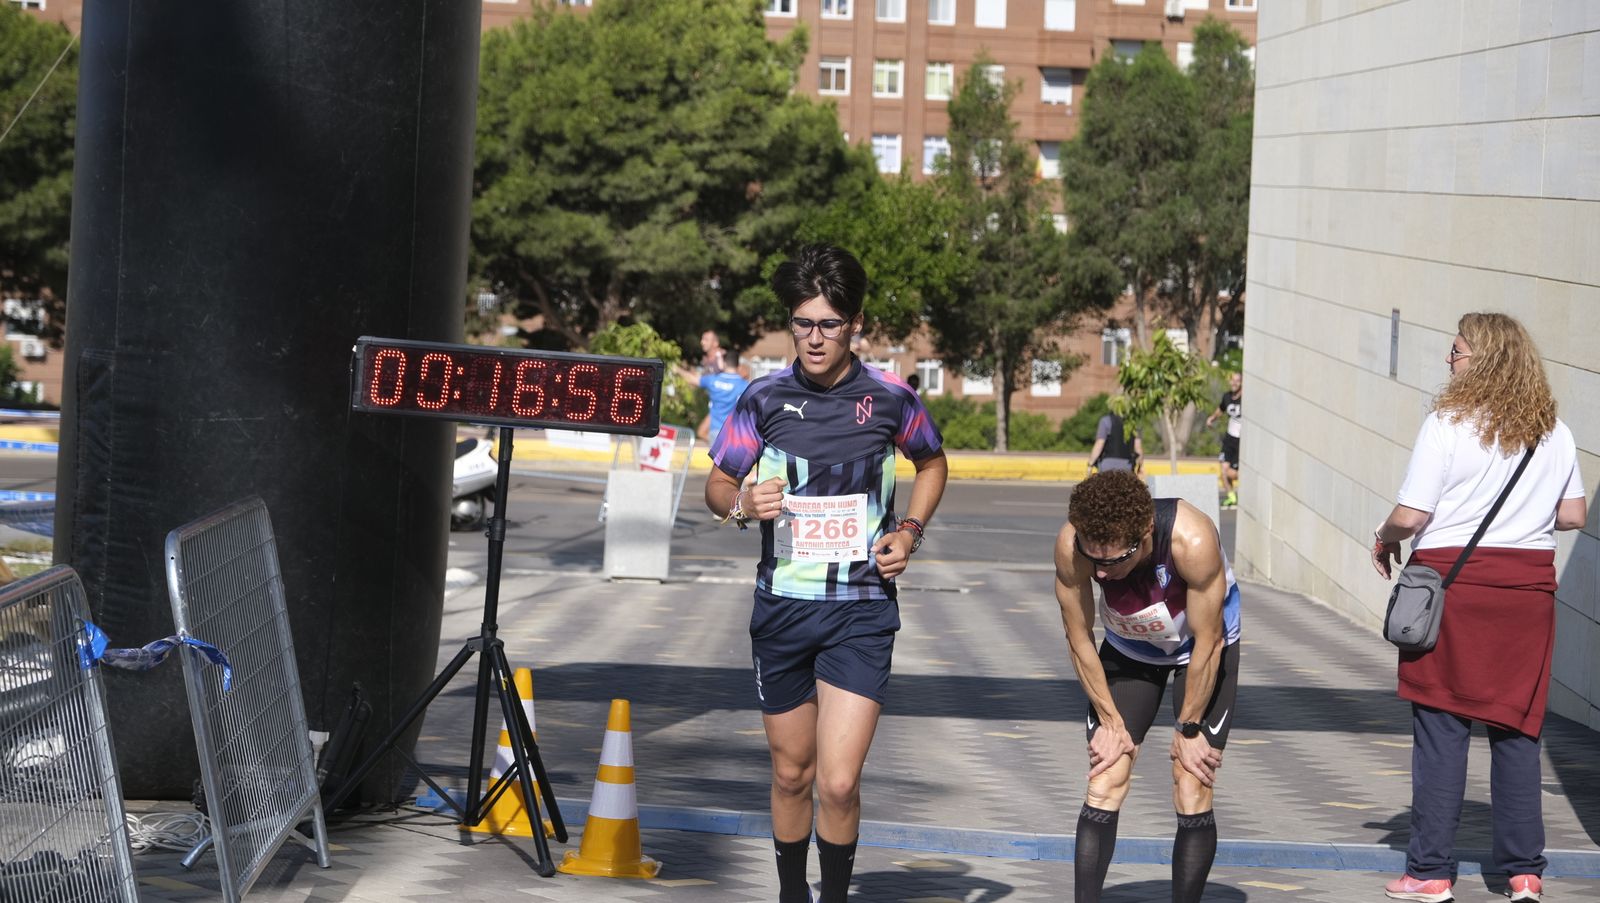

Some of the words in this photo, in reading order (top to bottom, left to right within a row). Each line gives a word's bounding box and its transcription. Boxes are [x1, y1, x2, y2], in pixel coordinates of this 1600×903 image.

[823, 501, 836, 509] SIN
[837, 500, 858, 508] HUMO
[791, 517, 858, 540] 1266
[795, 540, 824, 548] ANTONIO
[825, 540, 850, 548] ORTEGA
